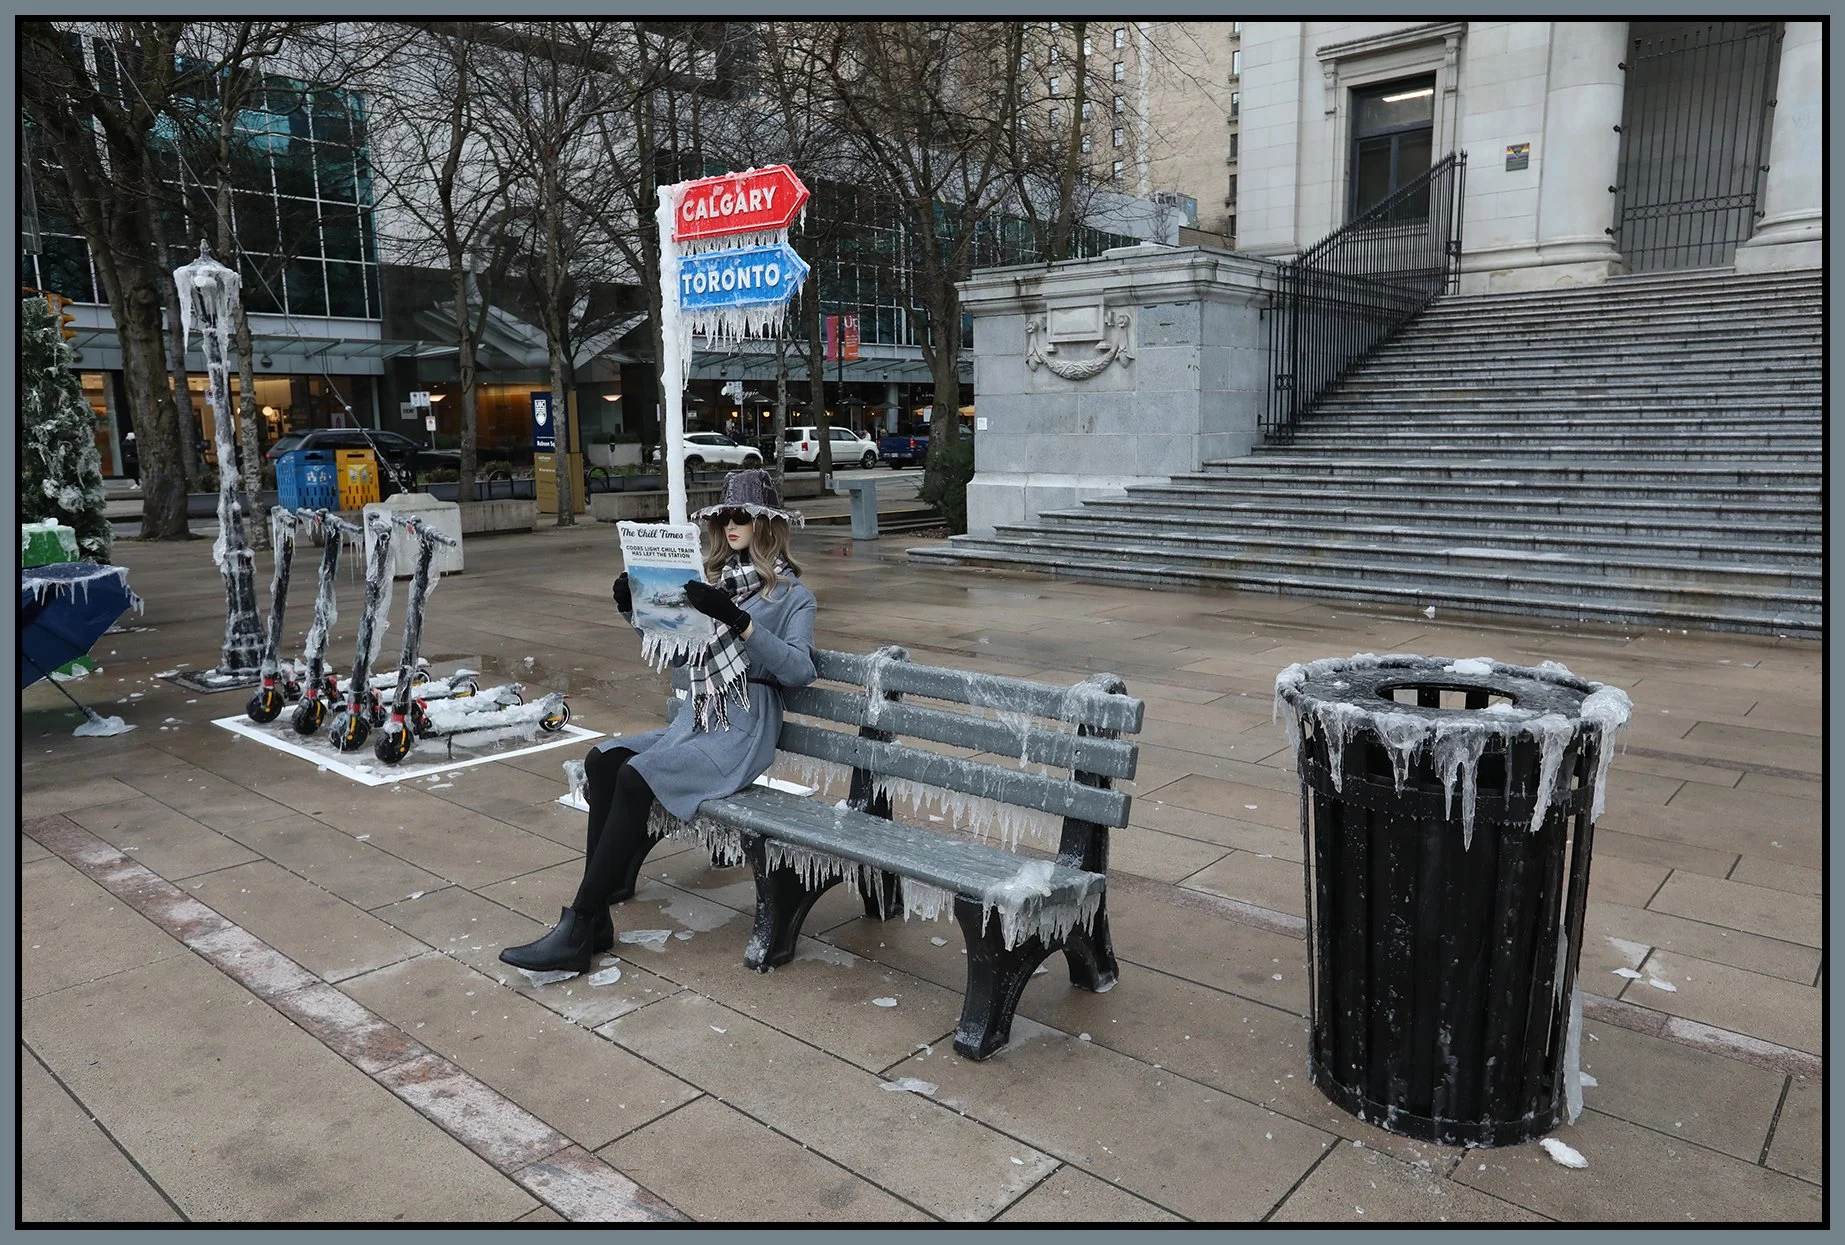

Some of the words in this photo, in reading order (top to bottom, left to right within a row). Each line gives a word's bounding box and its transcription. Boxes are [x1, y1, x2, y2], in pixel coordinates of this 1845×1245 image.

[682, 186, 777, 222] CALGARY
[682, 263, 780, 295] TORONTO
[621, 528, 635, 537] The
[637, 529, 658, 538] Chill
[660, 529, 684, 539] Times
